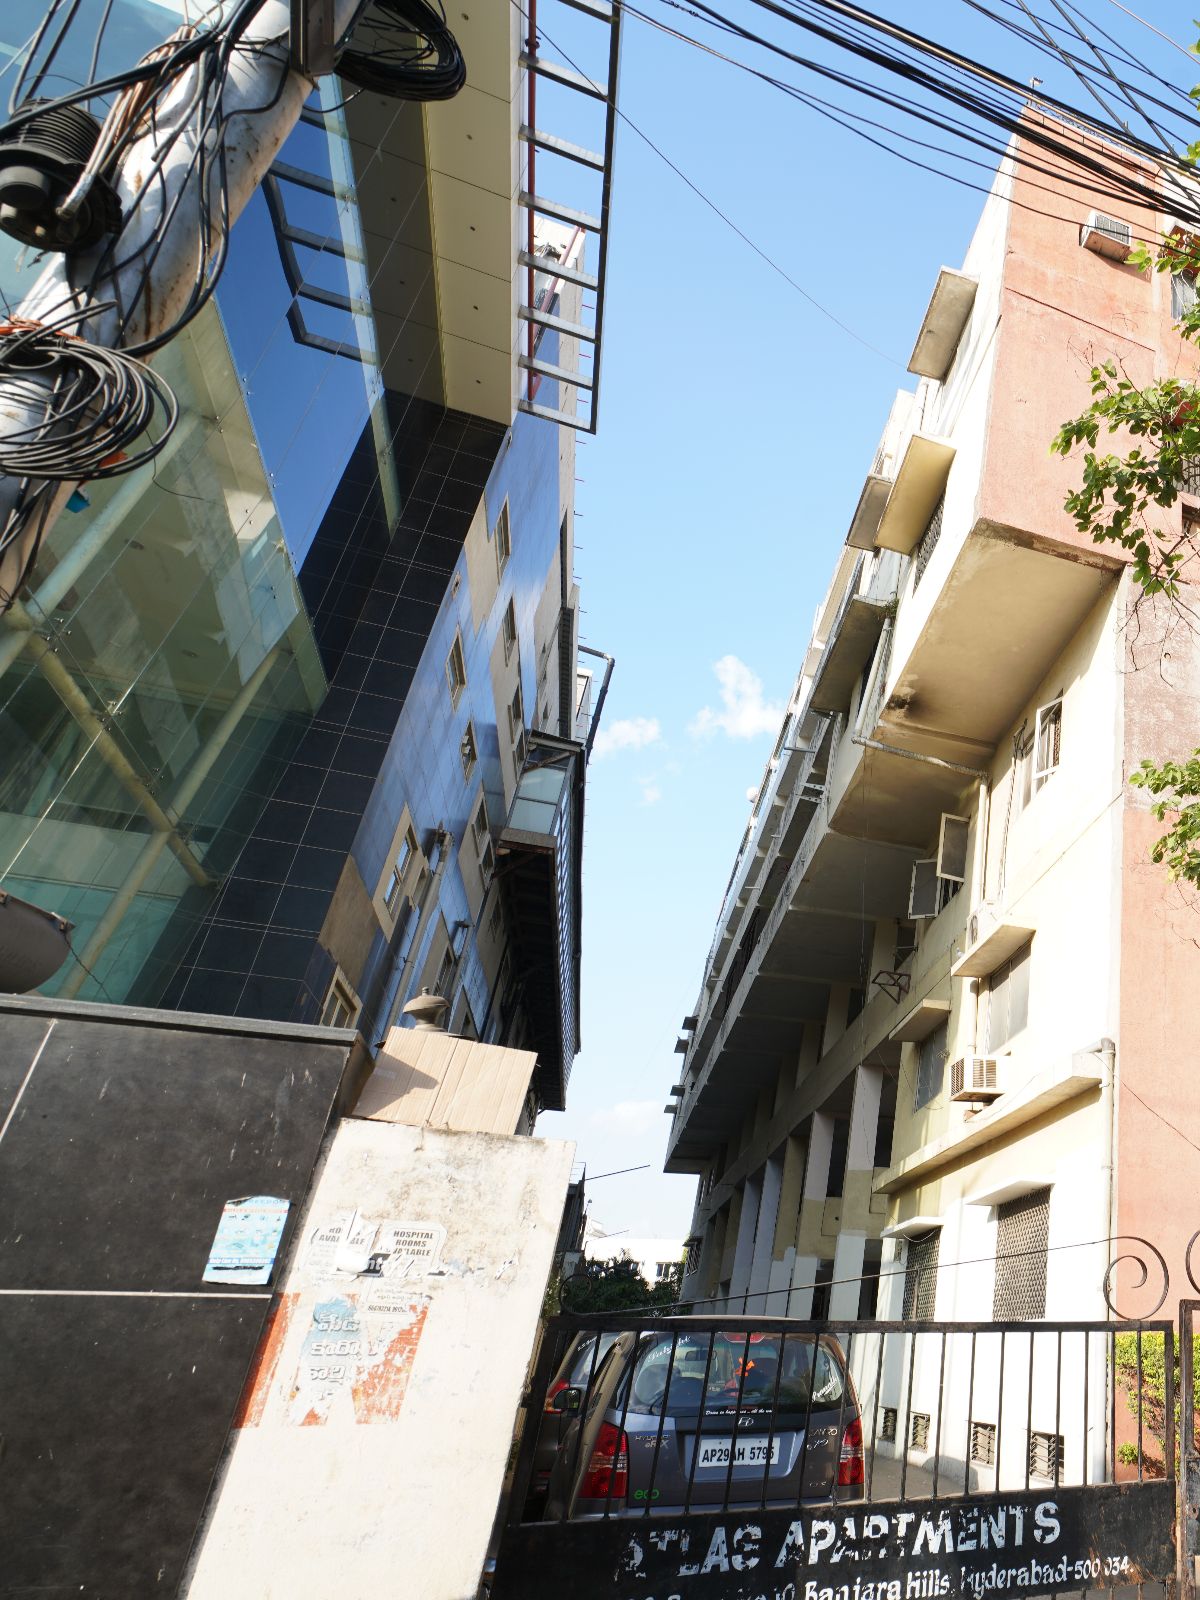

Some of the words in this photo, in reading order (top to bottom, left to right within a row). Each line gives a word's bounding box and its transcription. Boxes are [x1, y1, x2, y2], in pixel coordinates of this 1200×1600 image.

[393, 1230, 434, 1239] HOSPITAL
[395, 1239, 427, 1247] ROOMS
[702, 1447, 746, 1463] AP29H
[774, 1501, 1061, 1568] APARTMENTS
